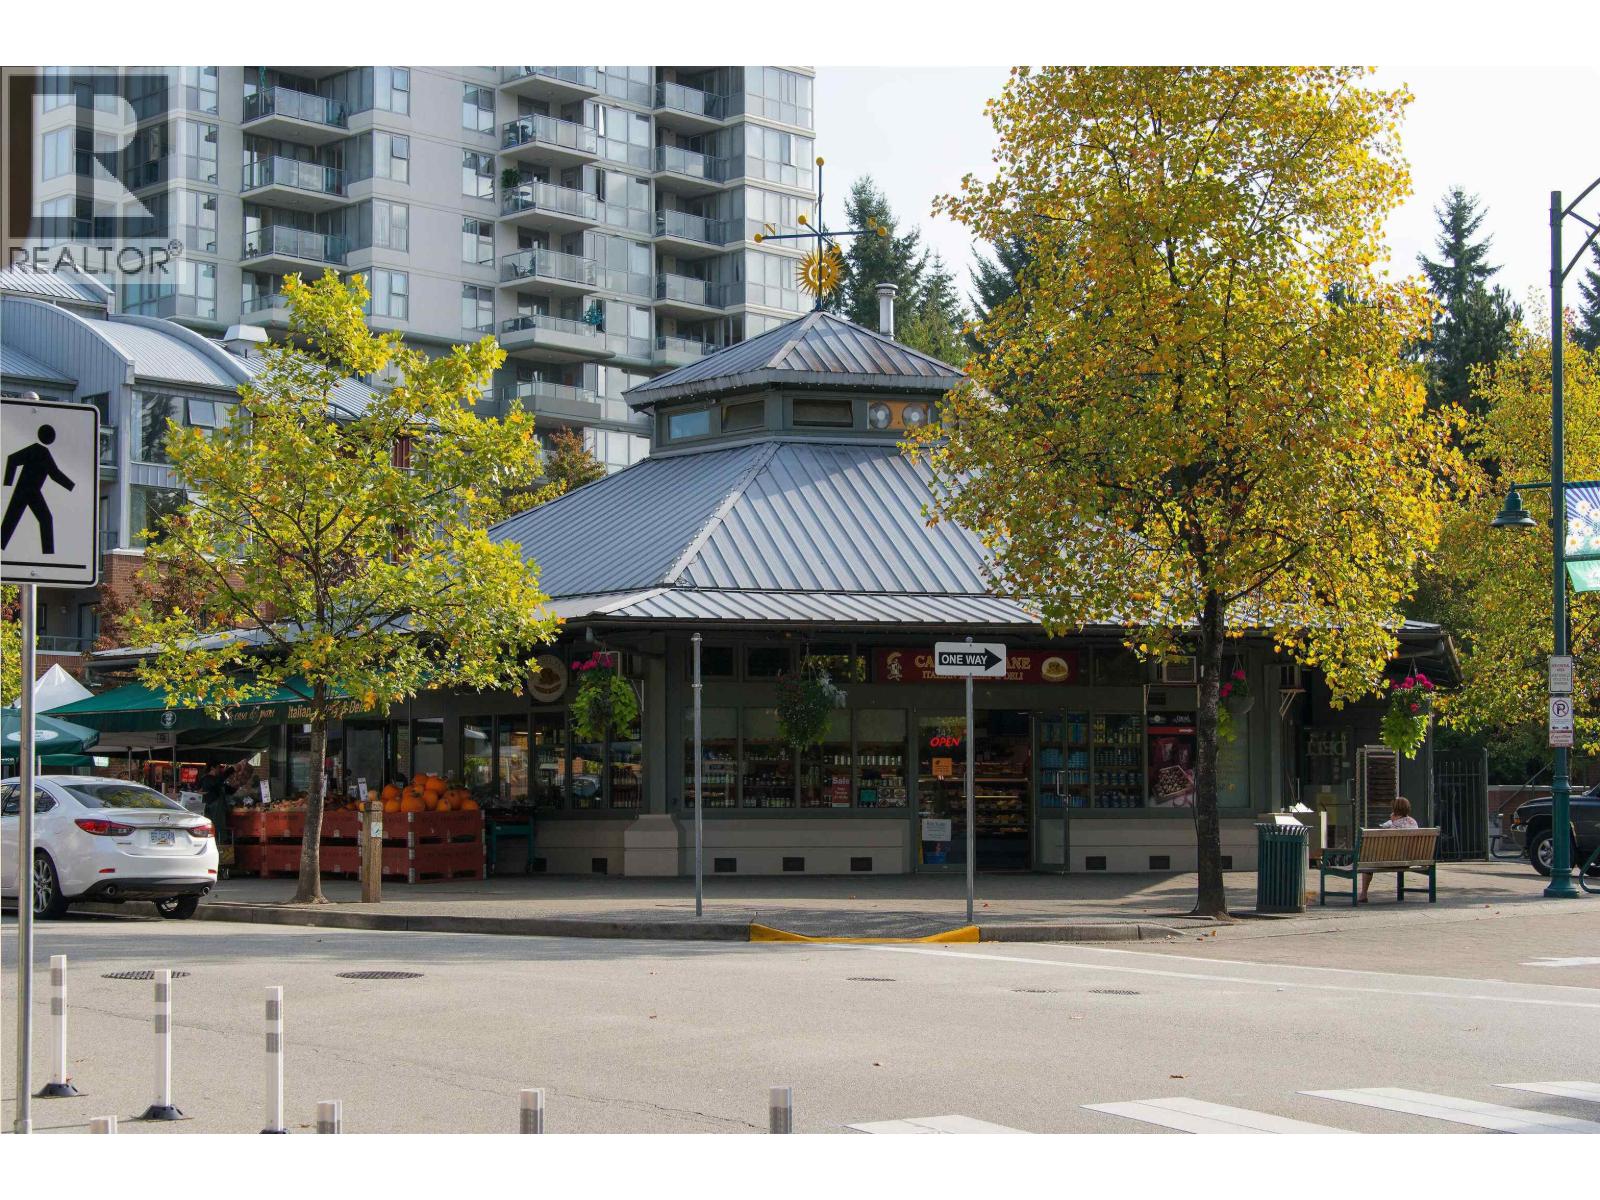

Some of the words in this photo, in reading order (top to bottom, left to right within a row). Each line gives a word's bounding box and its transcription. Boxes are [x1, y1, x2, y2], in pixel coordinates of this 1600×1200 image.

[941, 654, 963, 665] ONE
[966, 654, 988, 665] WAY
[1006, 657, 1031, 670] ANE
[929, 736, 961, 748] OPEN
